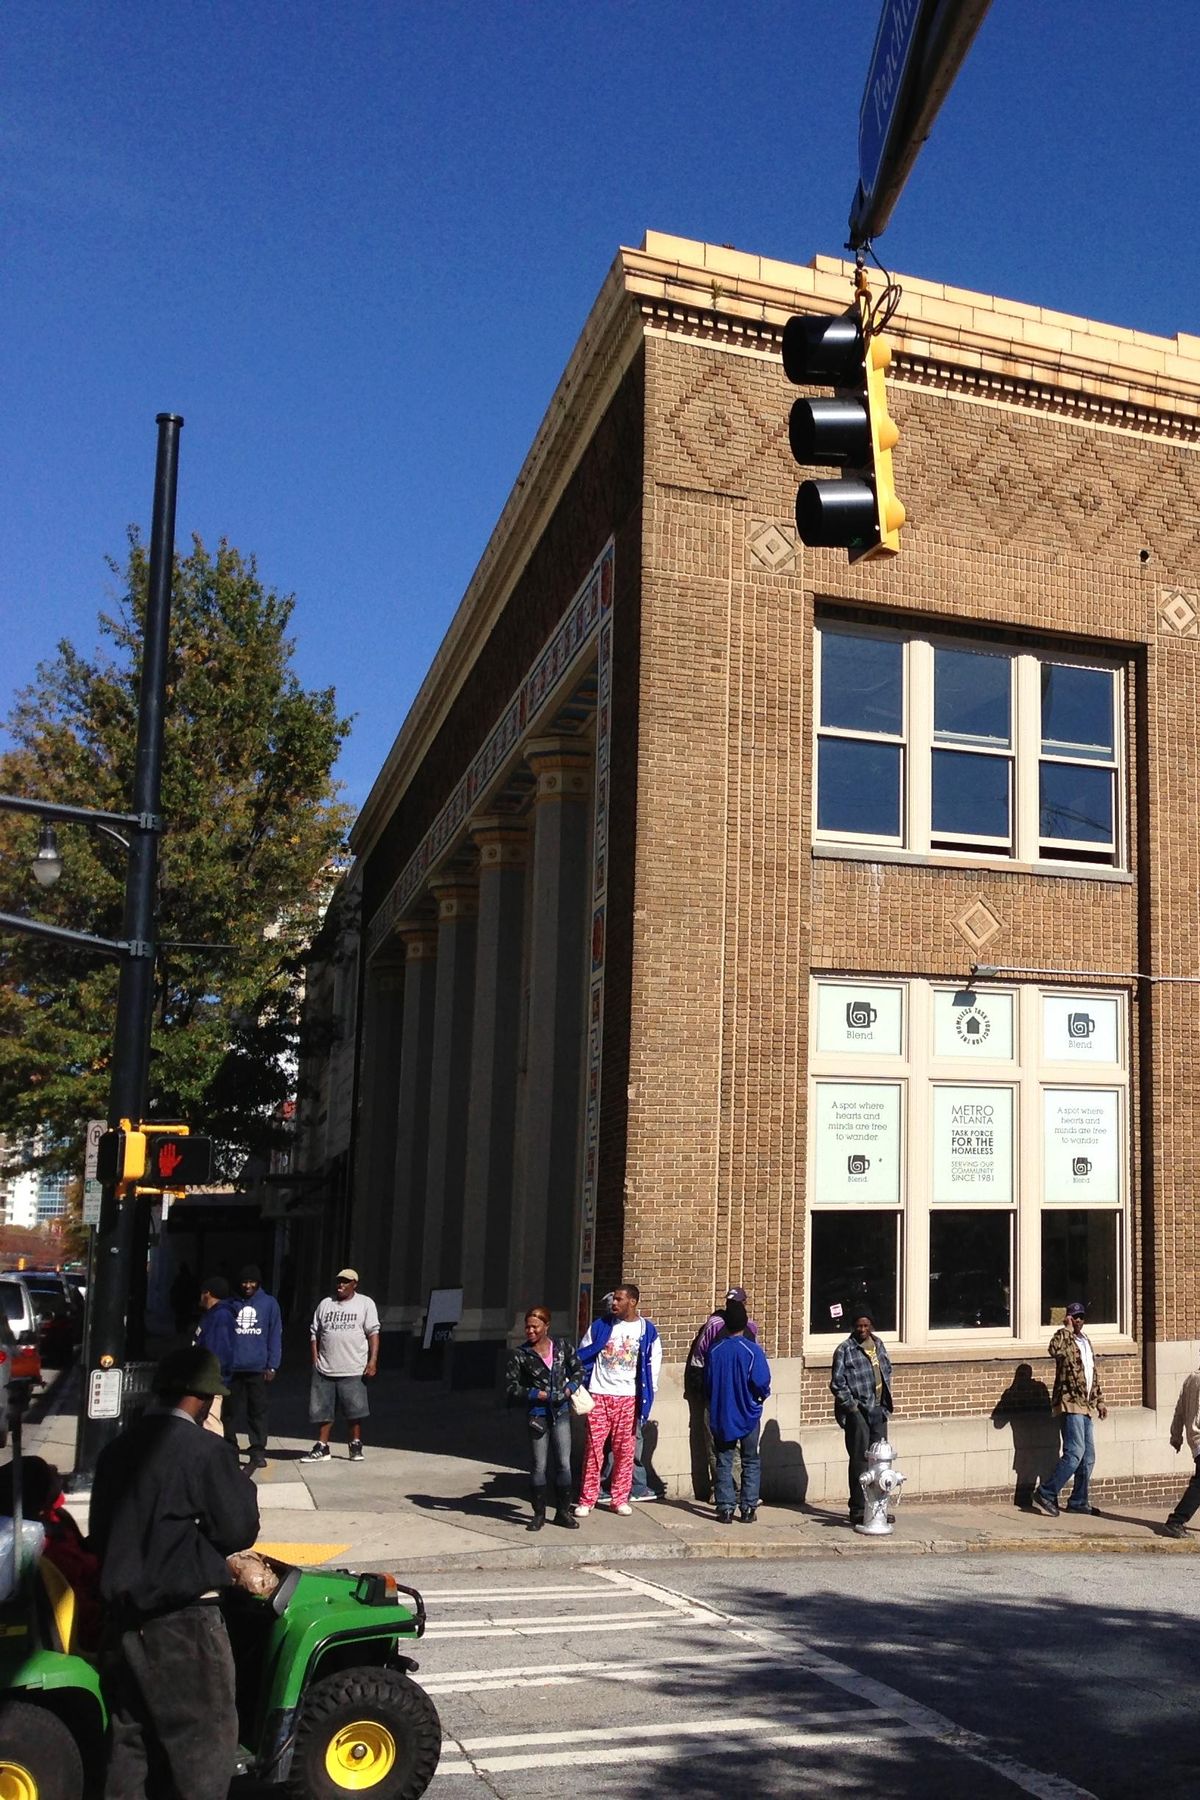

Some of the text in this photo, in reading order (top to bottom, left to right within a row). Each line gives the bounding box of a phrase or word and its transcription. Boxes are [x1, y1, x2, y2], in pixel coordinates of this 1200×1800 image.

[831, 1101, 885, 1110] A spot where
[951, 1105, 994, 1116] METRO
[836, 1112, 862, 1120] hearts
[951, 1115, 994, 1124] ATLANTA
[871, 1123, 888, 1131] free
[836, 1133, 845, 1141] to
[951, 1129, 969, 1137] TASK
[951, 1137, 994, 1147] FOR THE
[951, 1147, 994, 1155] HOMELESS
[951, 1174, 995, 1182] SINCE 1981
